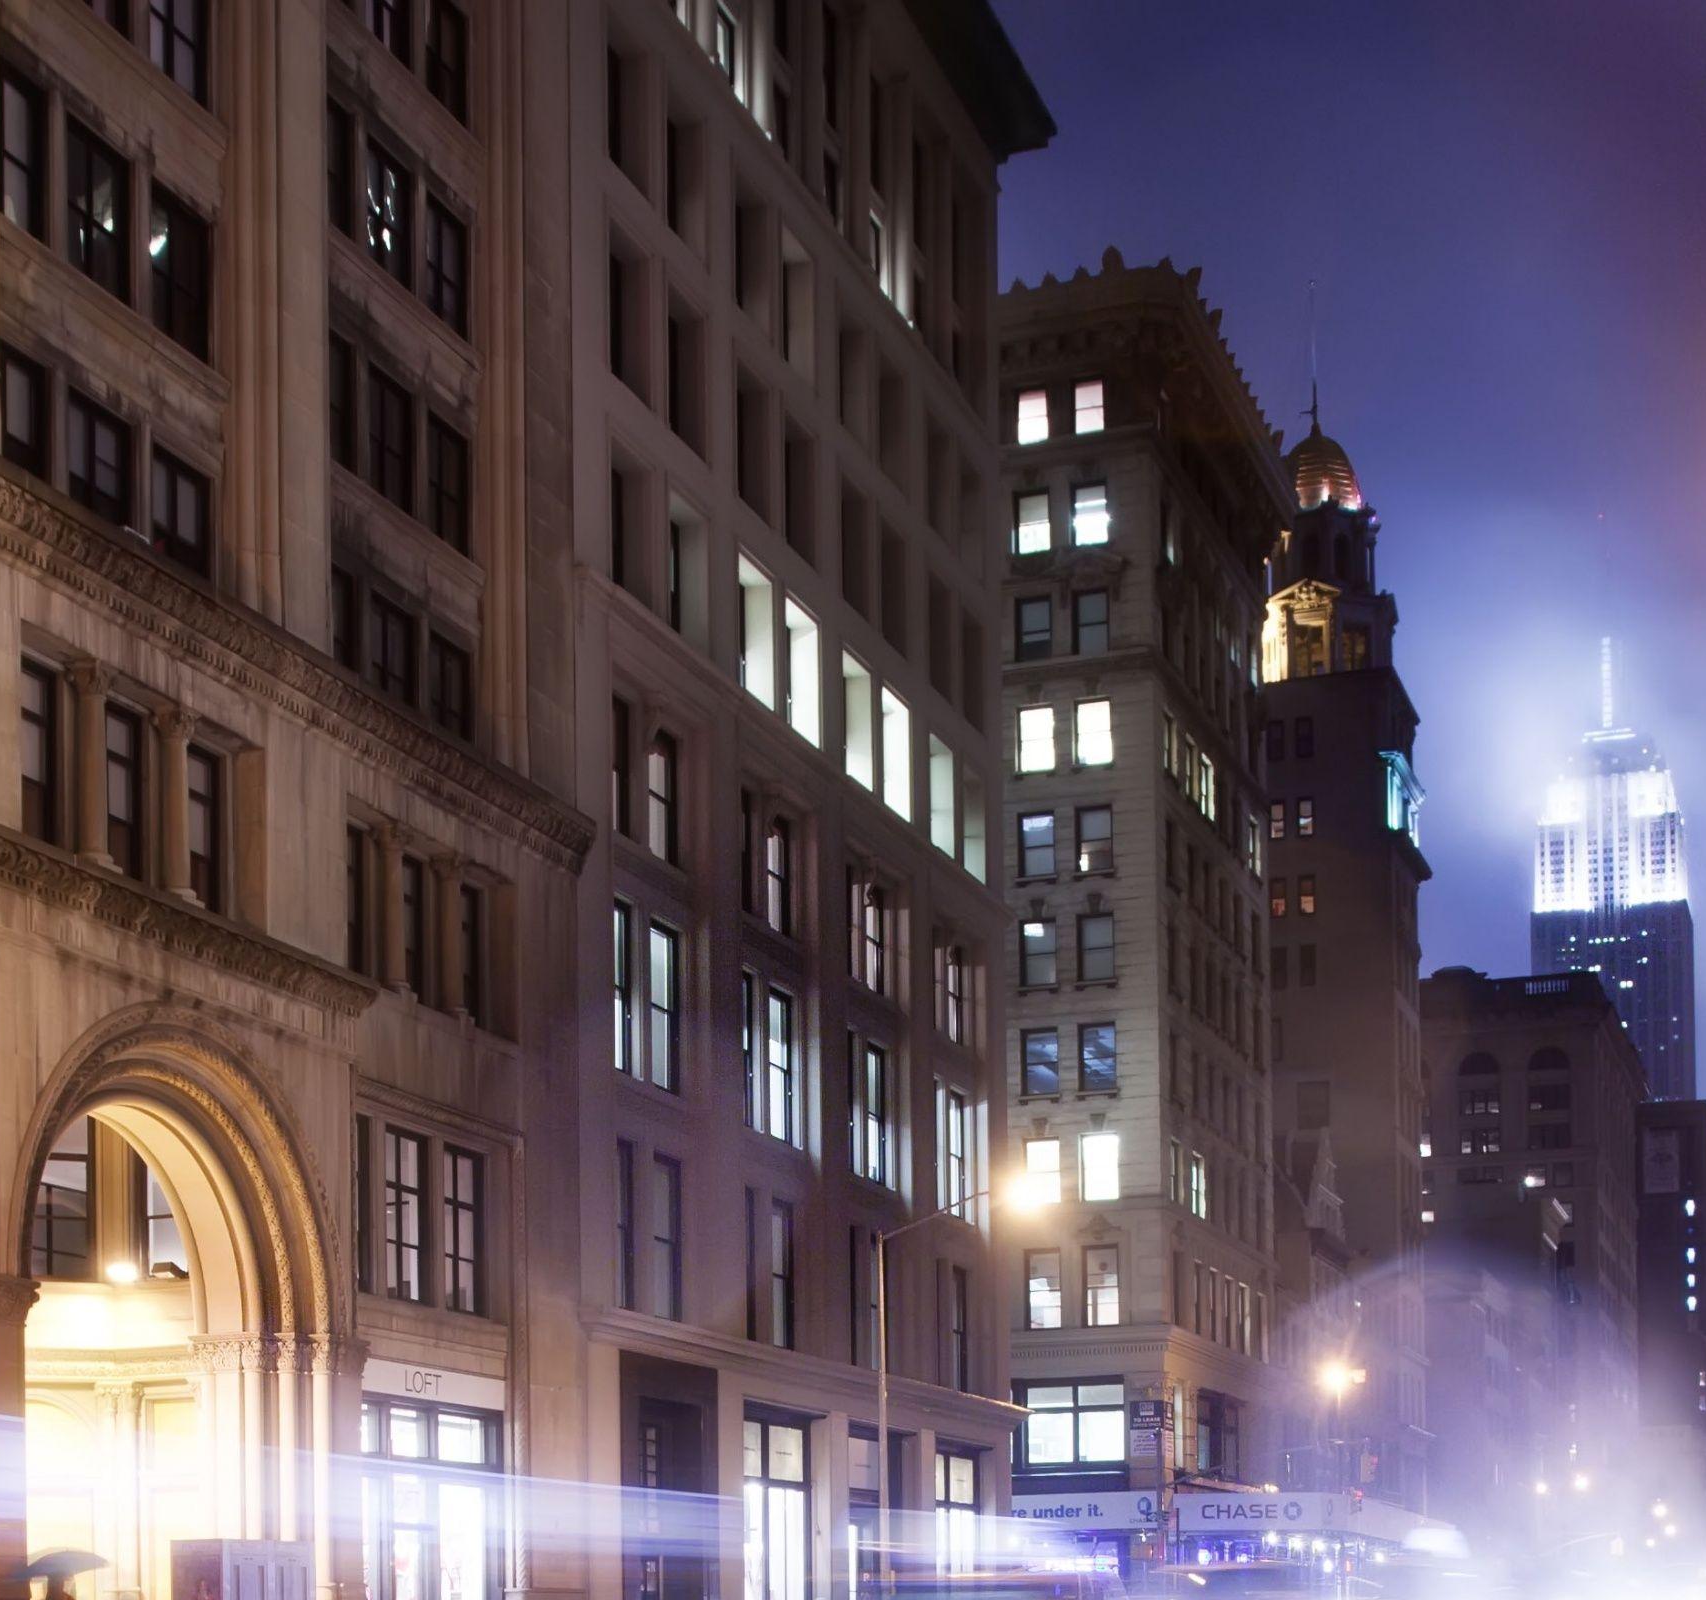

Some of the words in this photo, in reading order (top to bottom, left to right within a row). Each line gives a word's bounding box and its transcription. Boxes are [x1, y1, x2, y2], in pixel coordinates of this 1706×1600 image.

[405, 1369, 442, 1395] LOFT
[1033, 1504, 1083, 1518] under
[1087, 1503, 1104, 1517] it.
[1202, 1503, 1278, 1519] CHASE
